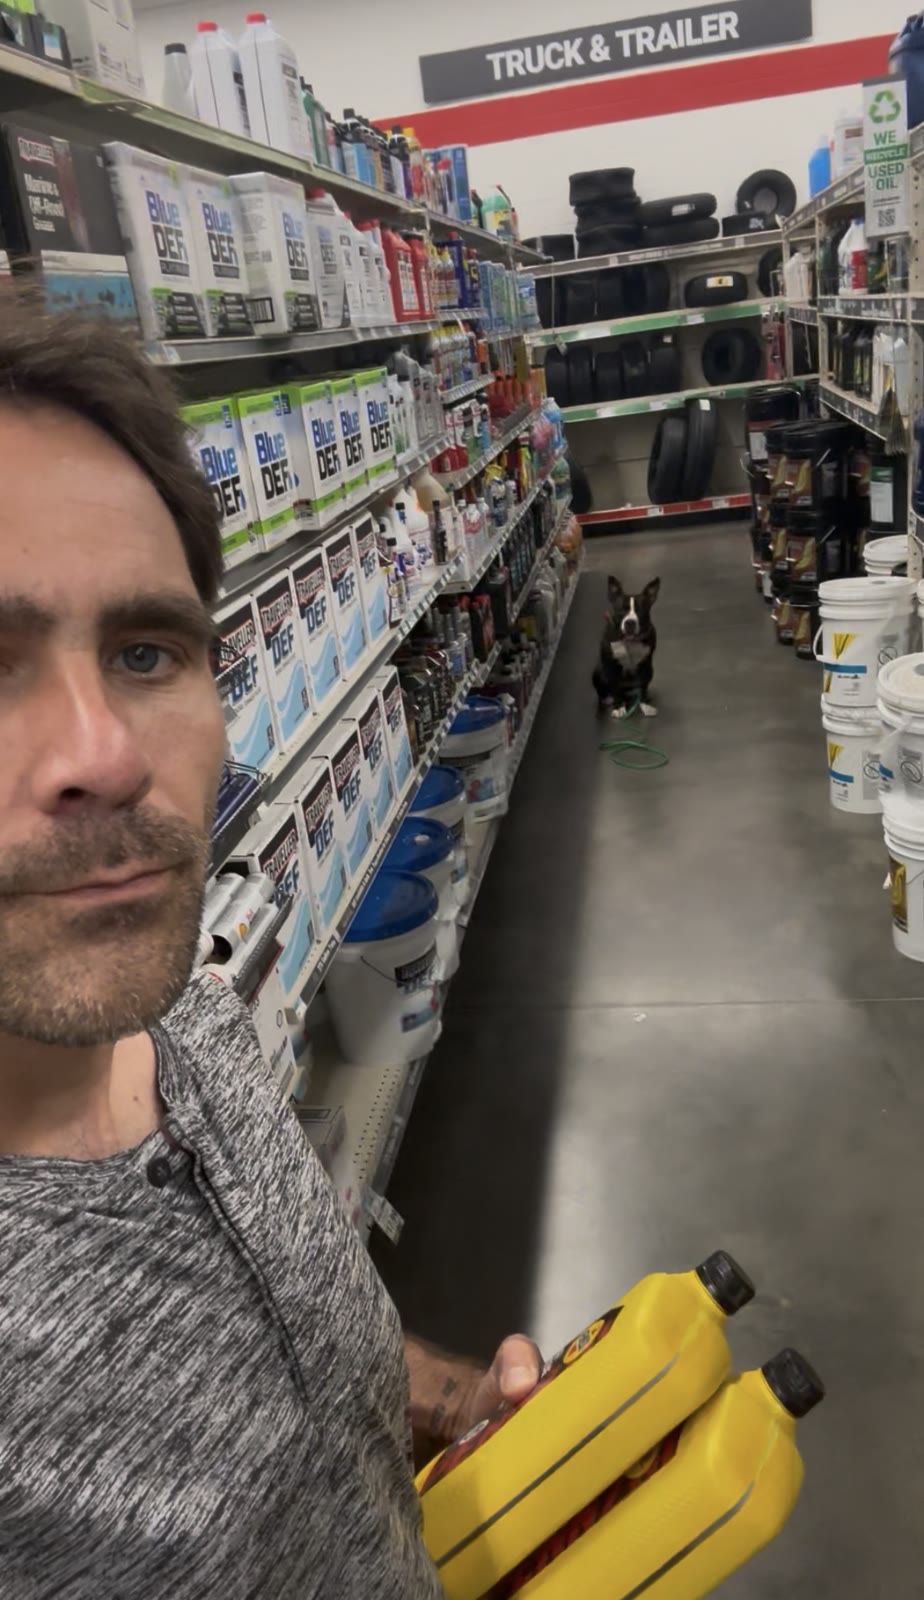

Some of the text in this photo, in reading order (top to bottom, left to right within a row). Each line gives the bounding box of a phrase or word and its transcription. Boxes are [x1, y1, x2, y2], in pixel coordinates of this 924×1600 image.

[486, 11, 740, 81] TRUCK & TRAILER
[873, 131, 897, 145] WE
[868, 162, 905, 179] USED
[876, 178, 898, 190] OIL
[145, 190, 182, 228] Blue
[202, 202, 232, 234] Blue
[152, 224, 188, 262] DEF
[207, 231, 238, 266] DEF
[286, 239, 308, 268] DEF
[340, 409, 360, 437] Blue
[367, 400, 388, 425] Blue
[255, 432, 286, 465] Blue
[312, 417, 336, 448] Blue
[344, 432, 364, 467] DEF
[370, 421, 392, 453] DEF
[200, 445, 238, 483] Blue
[261, 459, 290, 500] DEF
[316, 443, 340, 480] DEF
[337, 572, 355, 609] DEF
[261, 593, 291, 634] TRAVELLER
[305, 595, 327, 636] DEF
[272, 623, 294, 668] DEF
[342, 768, 361, 814] DEF
[315, 810, 334, 861] DEF
[263, 829, 298, 882] TRAVELLER
